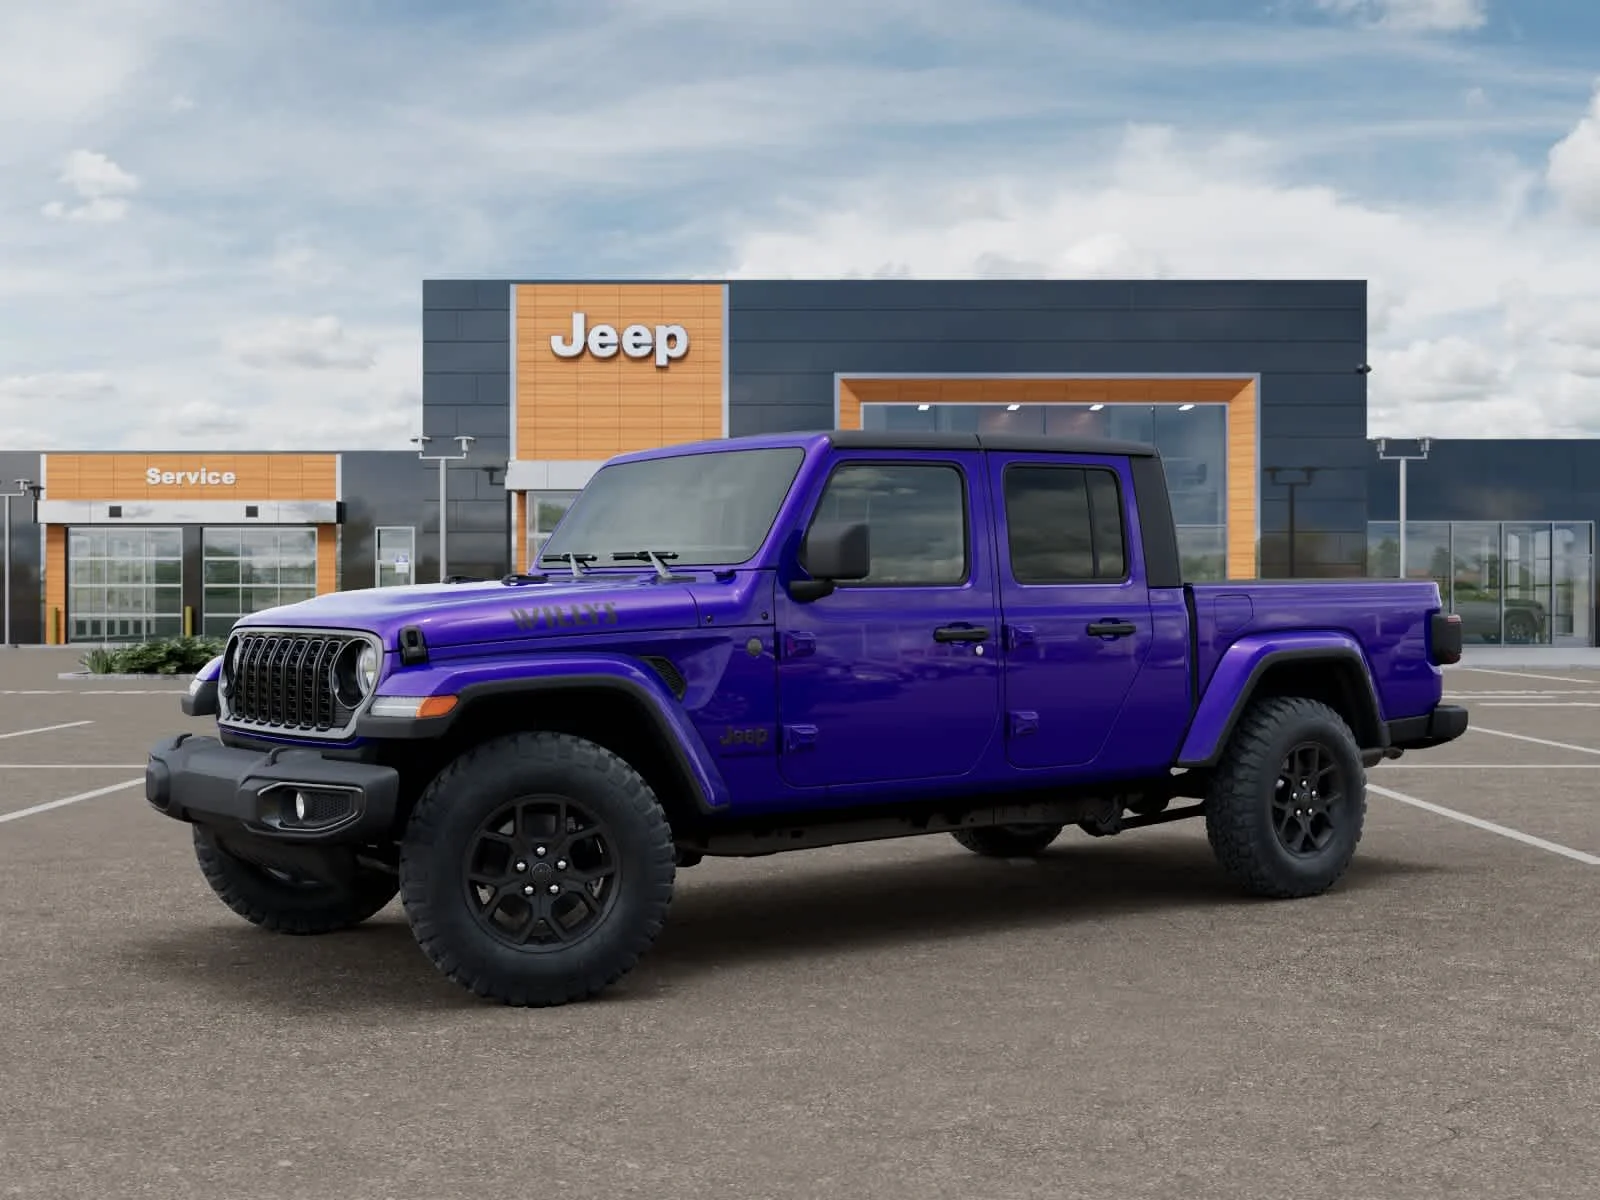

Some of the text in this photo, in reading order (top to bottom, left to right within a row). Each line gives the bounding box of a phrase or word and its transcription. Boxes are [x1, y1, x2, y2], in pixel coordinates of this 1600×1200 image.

[550, 311, 689, 367] Jeep
[146, 467, 237, 486] Service
[511, 602, 619, 630] WILLYS
[720, 725, 768, 748] Jeep
